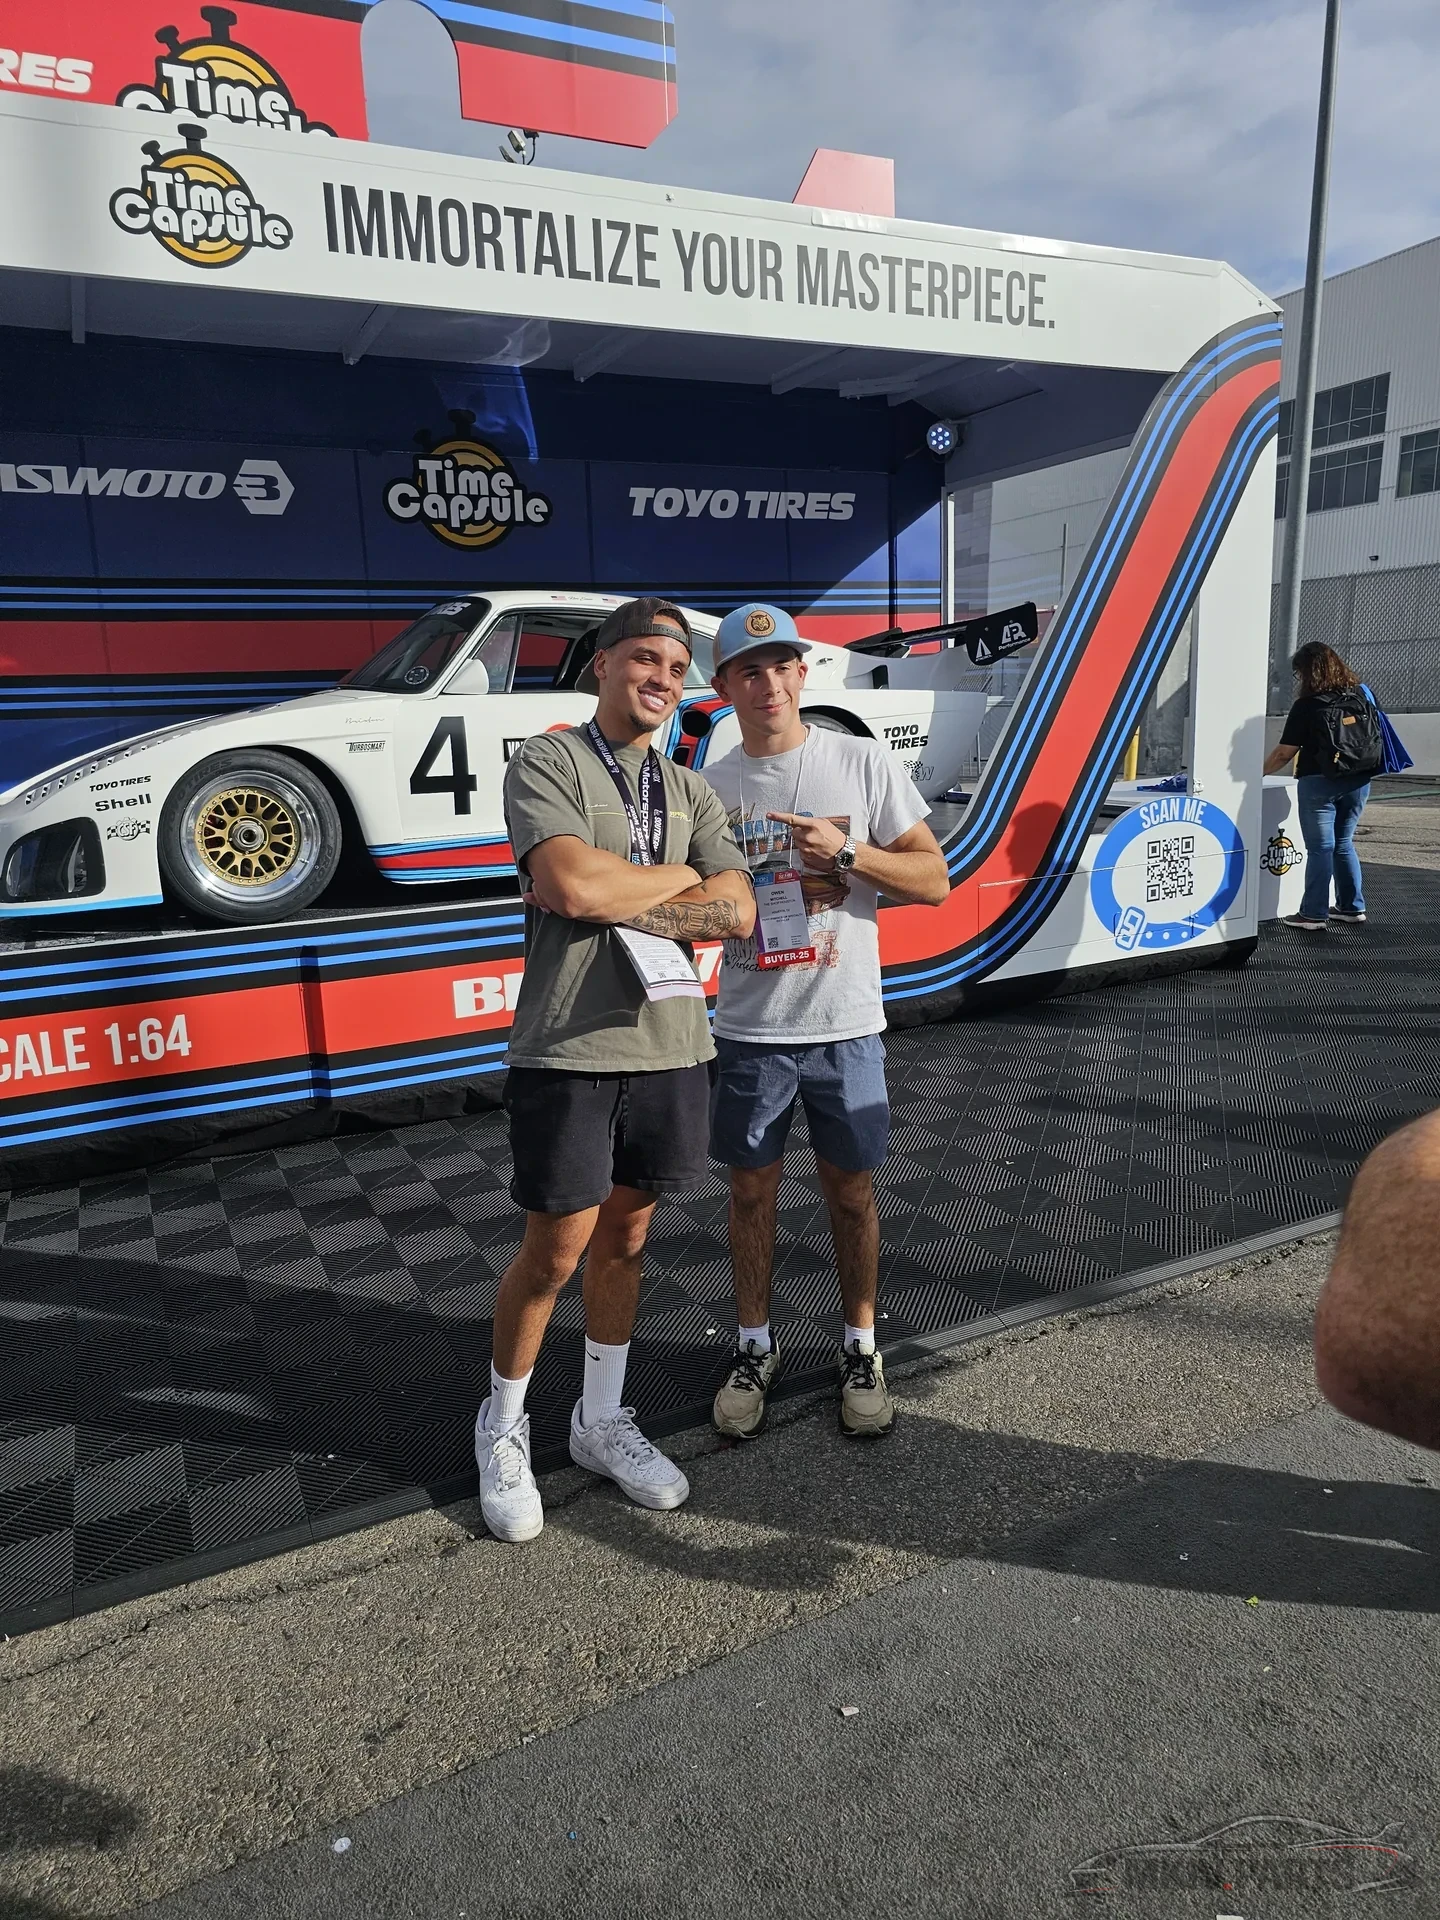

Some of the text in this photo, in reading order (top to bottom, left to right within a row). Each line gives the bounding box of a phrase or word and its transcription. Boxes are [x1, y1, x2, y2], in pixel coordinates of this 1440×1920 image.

[161, 62, 290, 123] Time
[146, 170, 250, 215] Time
[114, 192, 289, 245] Capsule
[323, 182, 1055, 329] IMMORTALIZE YOUR MASTERPIECE.
[418, 459, 514, 496] Time
[387, 482, 549, 528] Capsule
[628, 487, 856, 520] TOYO TIRES
[345, 740, 386, 752] TURBOSMART
[883, 724, 919, 739] TOYO
[890, 735, 929, 751] TIRES
[409, 715, 478, 816] 4
[89, 775, 152, 793] TOYO TIRES
[95, 793, 152, 812] Shell
[1139, 798, 1207, 829] SCAN ME
[1260, 851, 1303, 869] Capsule
[1268, 845, 1294, 858] Time
[764, 950, 810, 965] BUYER-25
[104, 1014, 192, 1066] 1:64
